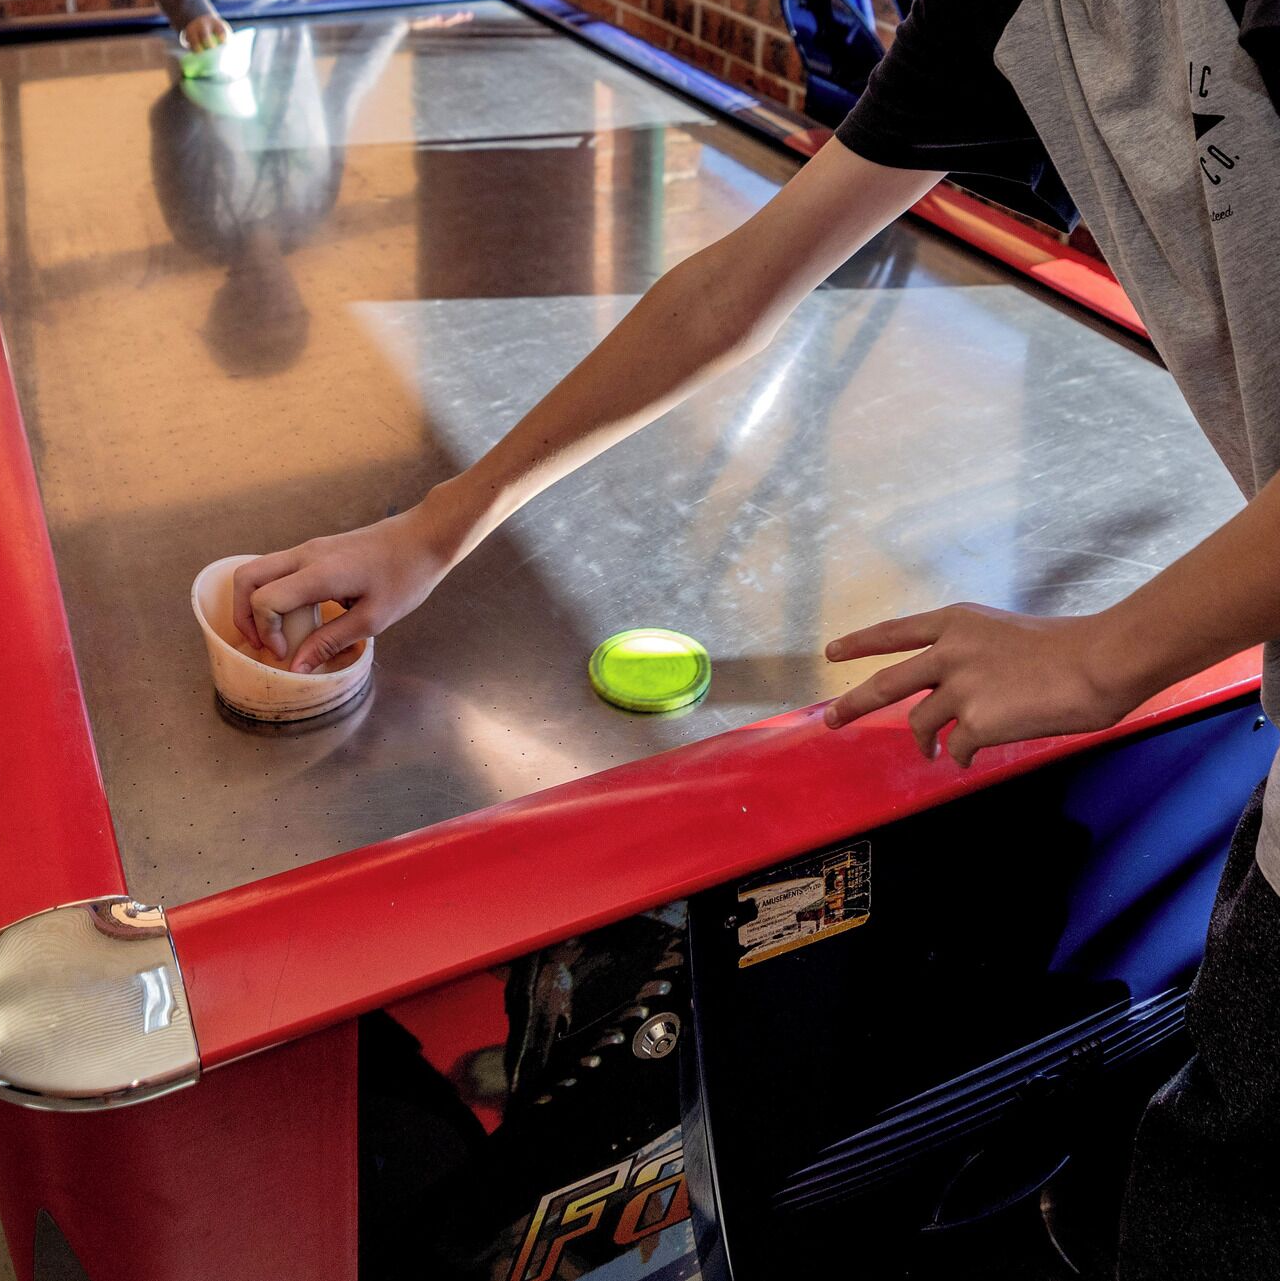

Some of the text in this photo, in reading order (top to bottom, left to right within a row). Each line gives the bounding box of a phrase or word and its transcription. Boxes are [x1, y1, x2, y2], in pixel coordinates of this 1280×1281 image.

[1199, 144, 1240, 186] CO.
[1210, 204, 1234, 221] teed
[761, 889, 803, 908] AMUSEMENTS
